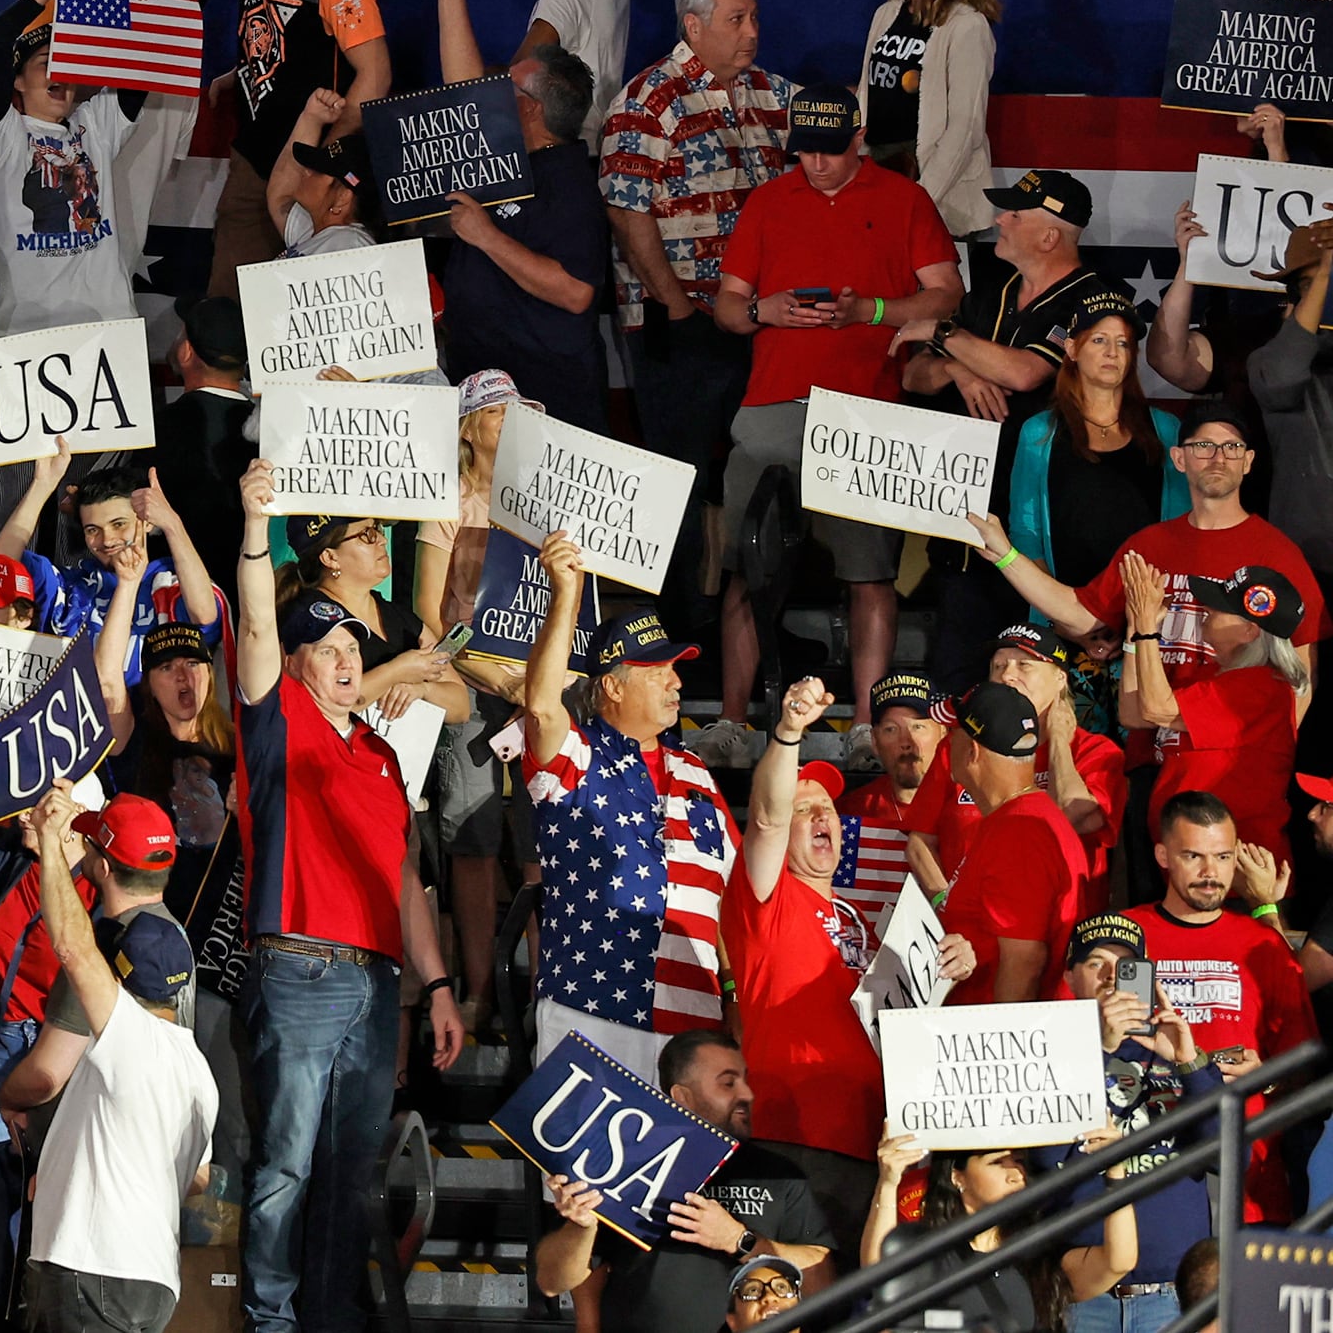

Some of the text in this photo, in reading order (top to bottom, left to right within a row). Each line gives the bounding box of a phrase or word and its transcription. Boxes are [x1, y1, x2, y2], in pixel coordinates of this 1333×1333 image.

[1217, 10, 1316, 44] MAKING
[1206, 39, 1317, 73] AMERICA
[1176, 63, 1333, 103] GREAT AGAIN
[398, 102, 480, 144] MAKING
[810, 99, 847, 115] AMERICA
[401, 131, 492, 173] AMERICA
[386, 152, 523, 204] GREAT AGAIN!
[1216, 183, 1314, 271] US
[287, 269, 384, 310] MAKING
[286, 299, 396, 341] AMERICA
[1088, 302, 1116, 314] GREAT
[260, 323, 424, 374] GREAT AGAIN!
[306, 406, 410, 437] MAKING
[299, 437, 417, 468] AMERICA
[810, 423, 989, 488] GOLDEN AGE
[270, 467, 445, 500] GREAT AGAIN!
[540, 442, 640, 502] MAKING
[526, 471, 634, 533] AMERICA
[816, 465, 970, 520] OF AMERICA
[500, 486, 660, 570] GREAT AGAIN!
[626, 617, 648, 634] MAKE
[998, 624, 1042, 643] TRUMP
[599, 640, 626, 666] 45-47
[892, 674, 931, 692] AMERICA
[2, 667, 105, 799] USA
[146, 834, 171, 844] TRUMP
[1076, 914, 1142, 937] MAKE AMERICA
[1082, 927, 1111, 945] GREAT
[1156, 960, 1233, 973] AUTO WORKERS
[1181, 1009, 1212, 1024] 2024
[935, 1029, 1048, 1065] MAKING
[932, 1063, 1059, 1097] AMERICA
[901, 1091, 1093, 1132] GREAT AGAIN!
[532, 1061, 687, 1223] USA
